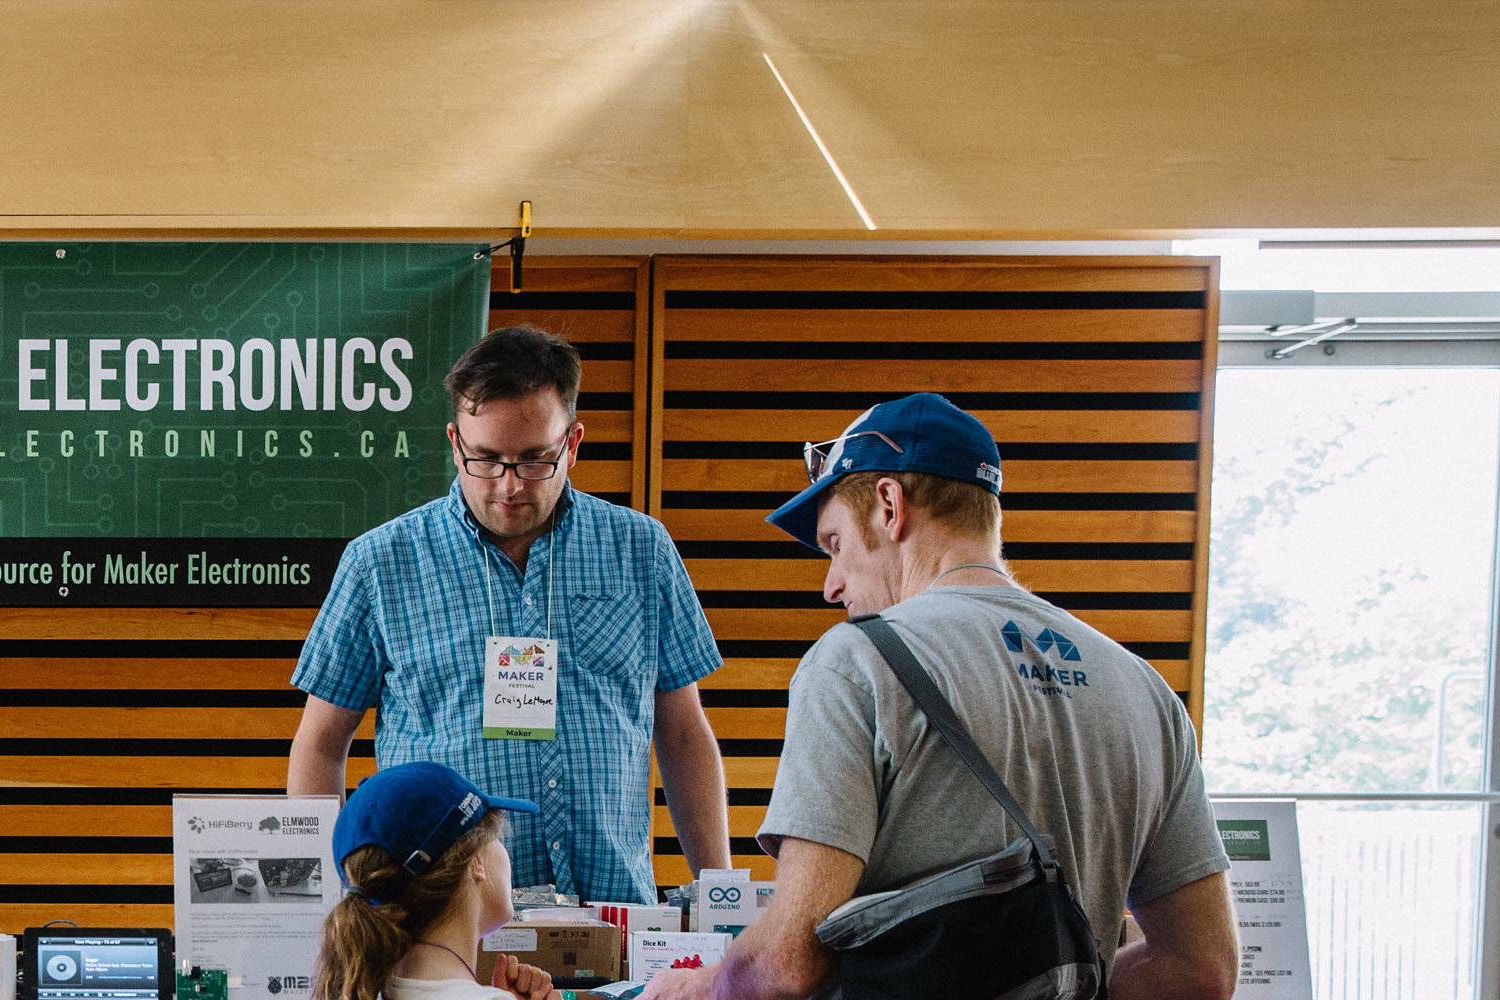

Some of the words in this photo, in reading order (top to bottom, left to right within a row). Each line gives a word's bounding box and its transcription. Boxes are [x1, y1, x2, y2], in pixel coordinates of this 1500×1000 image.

[18, 337, 414, 411] ELECTRONICS
[61, 551, 96, 584] for
[103, 551, 179, 584] Maker
[187, 551, 311, 584] Electronics
[498, 671, 544, 681] MAKER
[1017, 664, 1089, 687] MAKER
[494, 694, 522, 708] Craig
[208, 820, 253, 830] HiFiBerry
[282, 817, 319, 827] ELMWOOD
[1220, 831, 1260, 840] ECTRONICS
